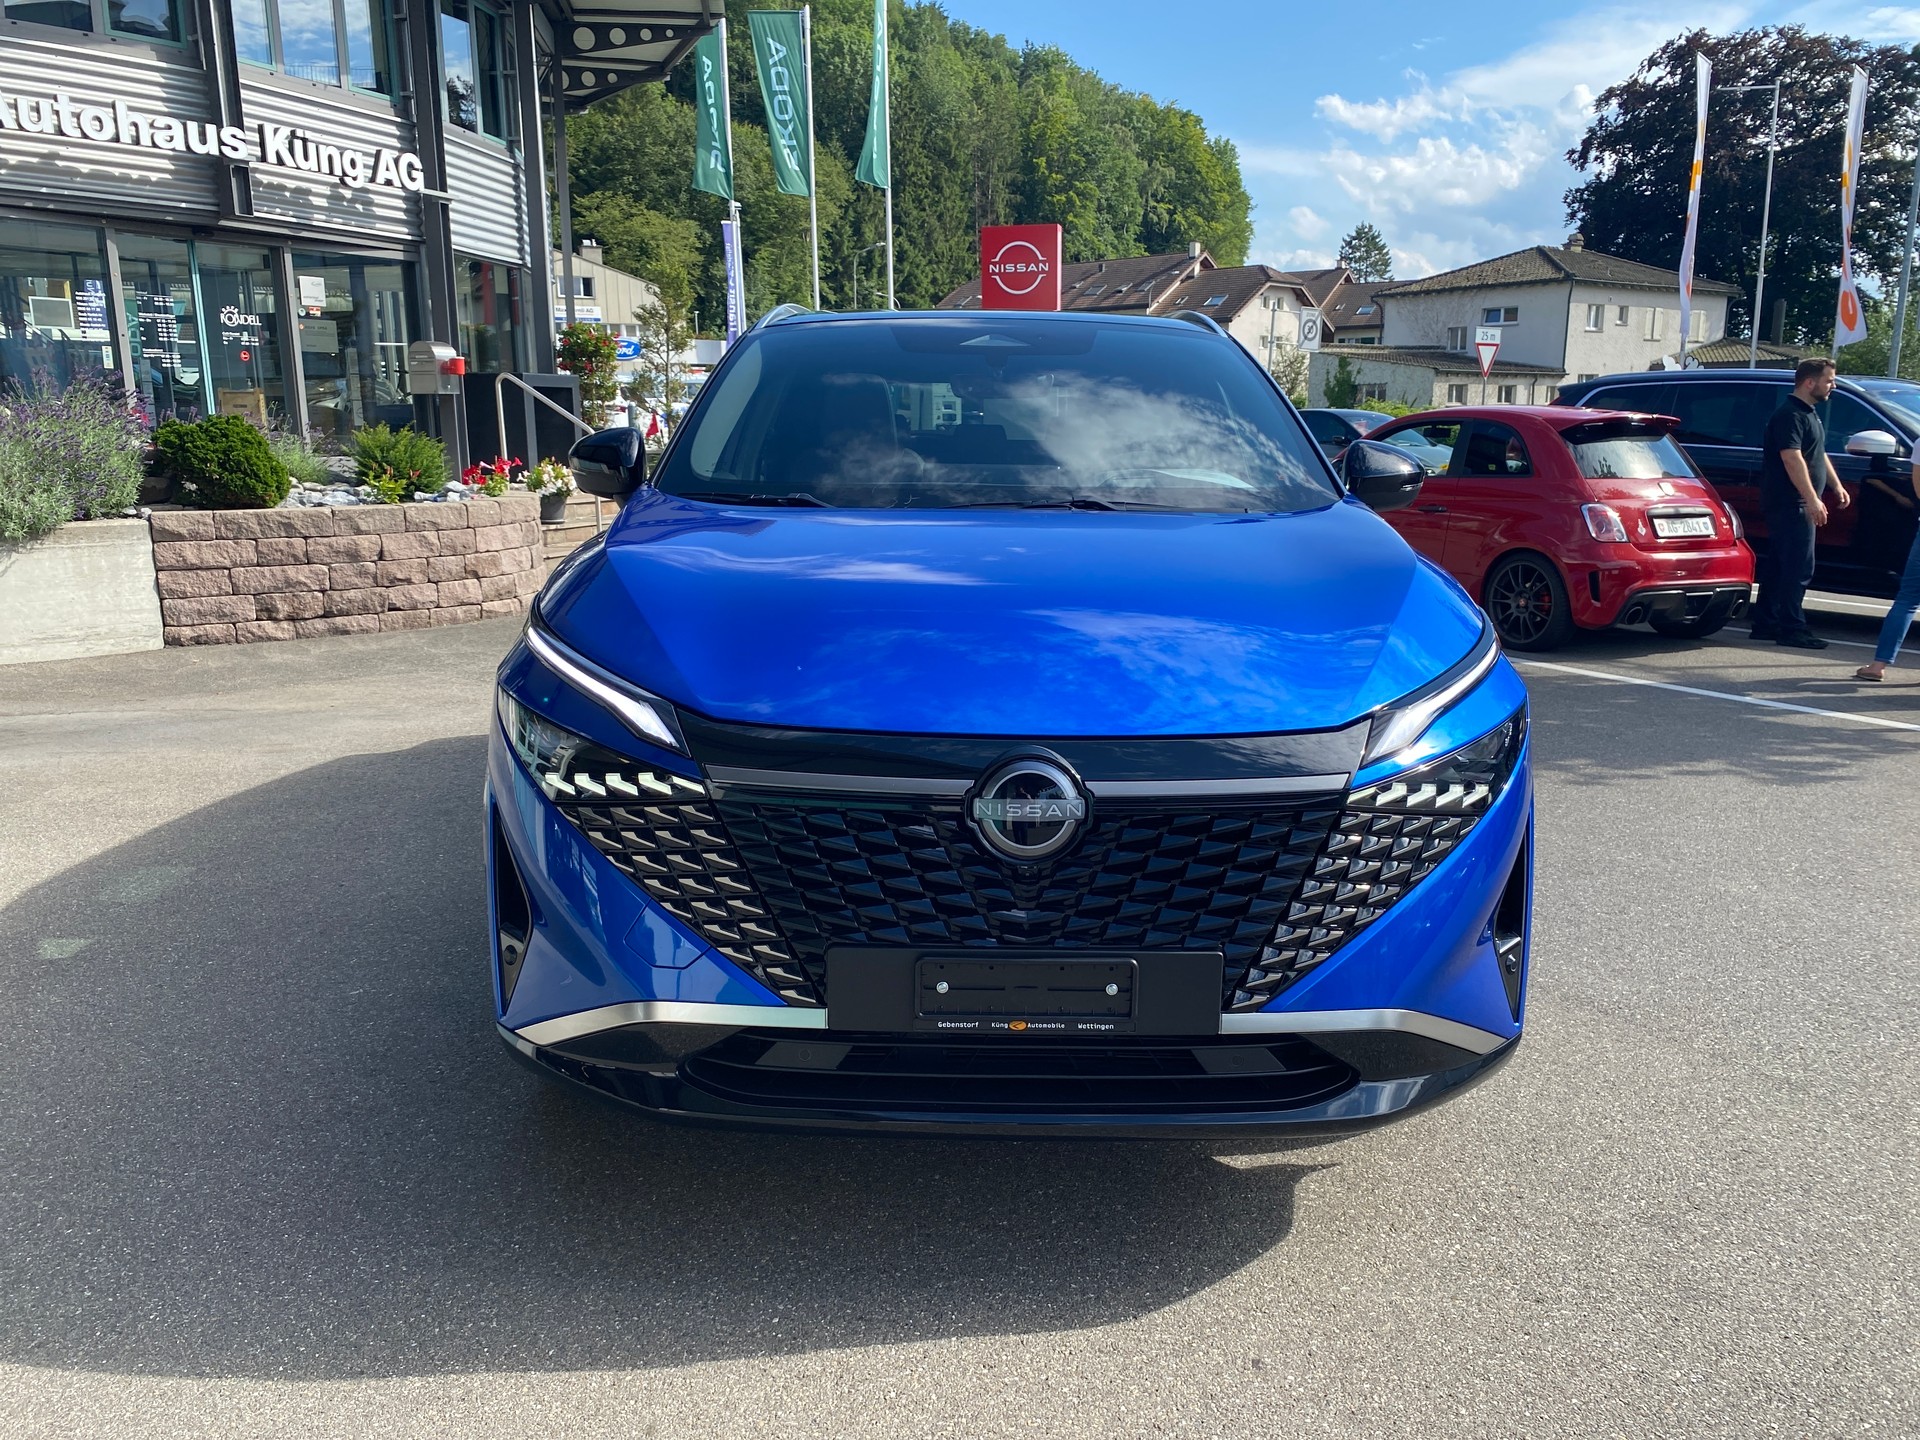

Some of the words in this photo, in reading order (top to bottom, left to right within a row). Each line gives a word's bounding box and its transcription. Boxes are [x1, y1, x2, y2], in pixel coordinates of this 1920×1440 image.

[260, 123, 365, 188] Küng
[372, 149, 425, 191] AG
[989, 262, 1049, 273] NISSAN
[1481, 331, 1489, 341] 25
[1490, 333, 1496, 341] m
[976, 803, 1082, 817] NISSAN
[991, 1021, 1008, 1029] Küng
[1077, 1023, 1114, 1031] Wettingen
